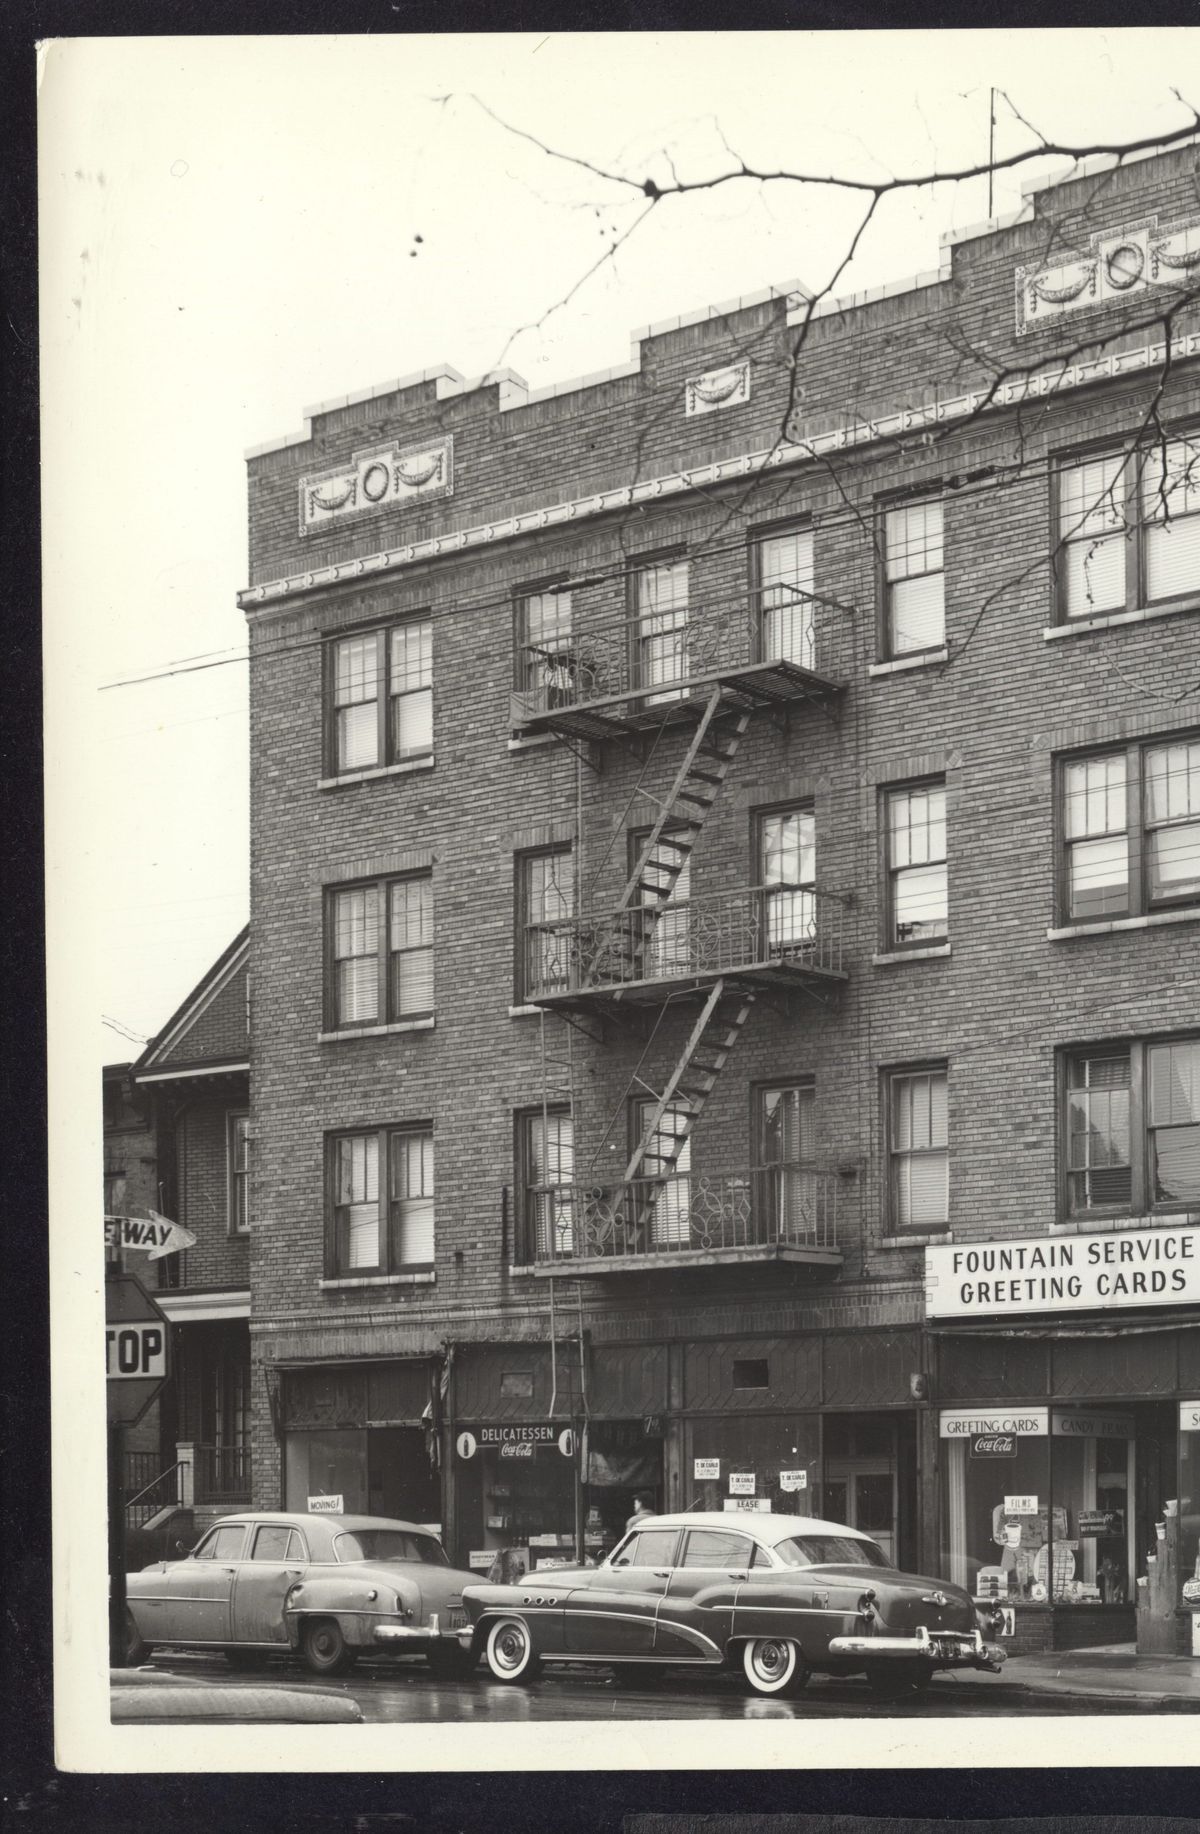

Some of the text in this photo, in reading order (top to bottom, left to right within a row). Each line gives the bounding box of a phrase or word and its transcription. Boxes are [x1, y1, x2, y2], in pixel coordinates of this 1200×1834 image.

[123, 1221, 173, 1246] WAY
[953, 1236, 1195, 1274] FOUNTAIN SERVICE
[960, 1269, 1186, 1304] GREETING CARDS
[946, 1419, 1039, 1434] GREETING CARDS
[1061, 1419, 1095, 1433] CANDY
[481, 1427, 554, 1441] DELICATESSEN
[737, 1500, 759, 1508] LEASE
[1011, 1498, 1032, 1508] FILMS
